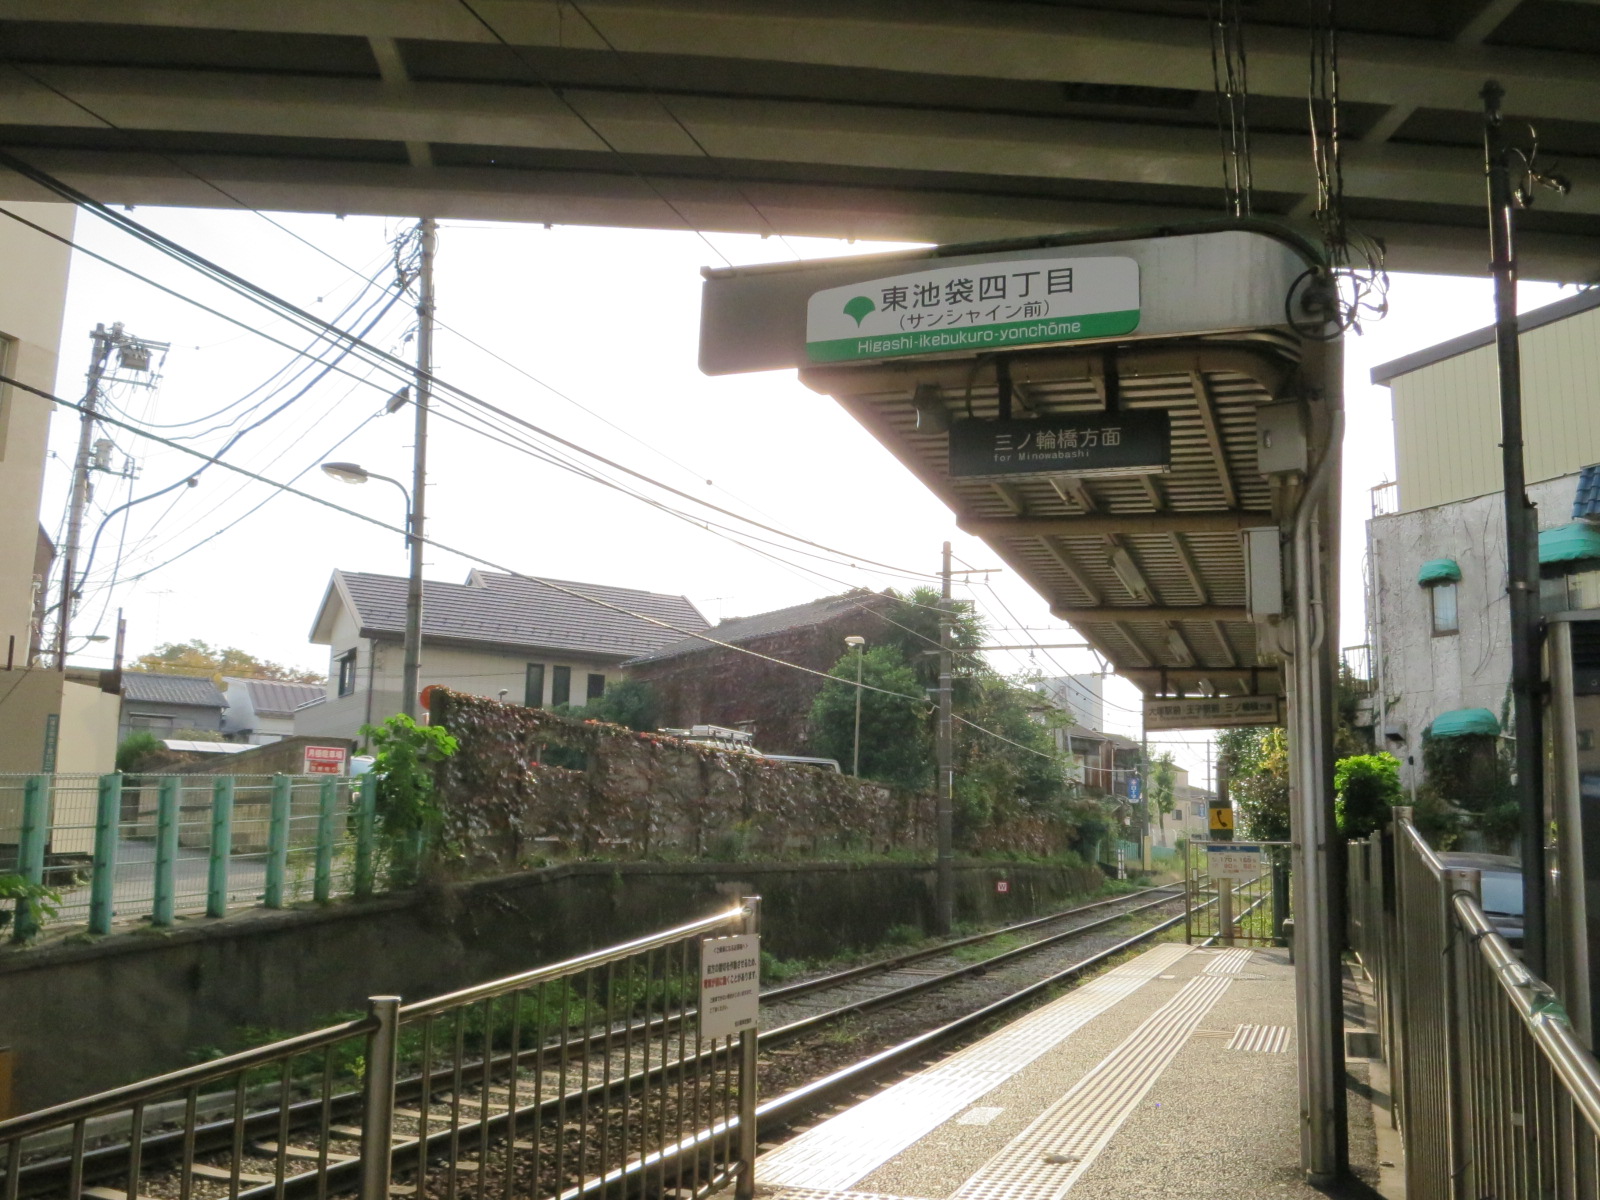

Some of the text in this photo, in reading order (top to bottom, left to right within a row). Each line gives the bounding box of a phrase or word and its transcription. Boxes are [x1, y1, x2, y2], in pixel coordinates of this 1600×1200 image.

[881, 267, 1074, 312] 東池袋四丁目
[900, 299, 1050, 331] (サンシャイン前)
[857, 321, 1081, 354] Higashi-ikebukuro-yonchōme
[994, 427, 1122, 451] 三ノ輪橋方面
[994, 449, 1089, 462] for Minowabashi
